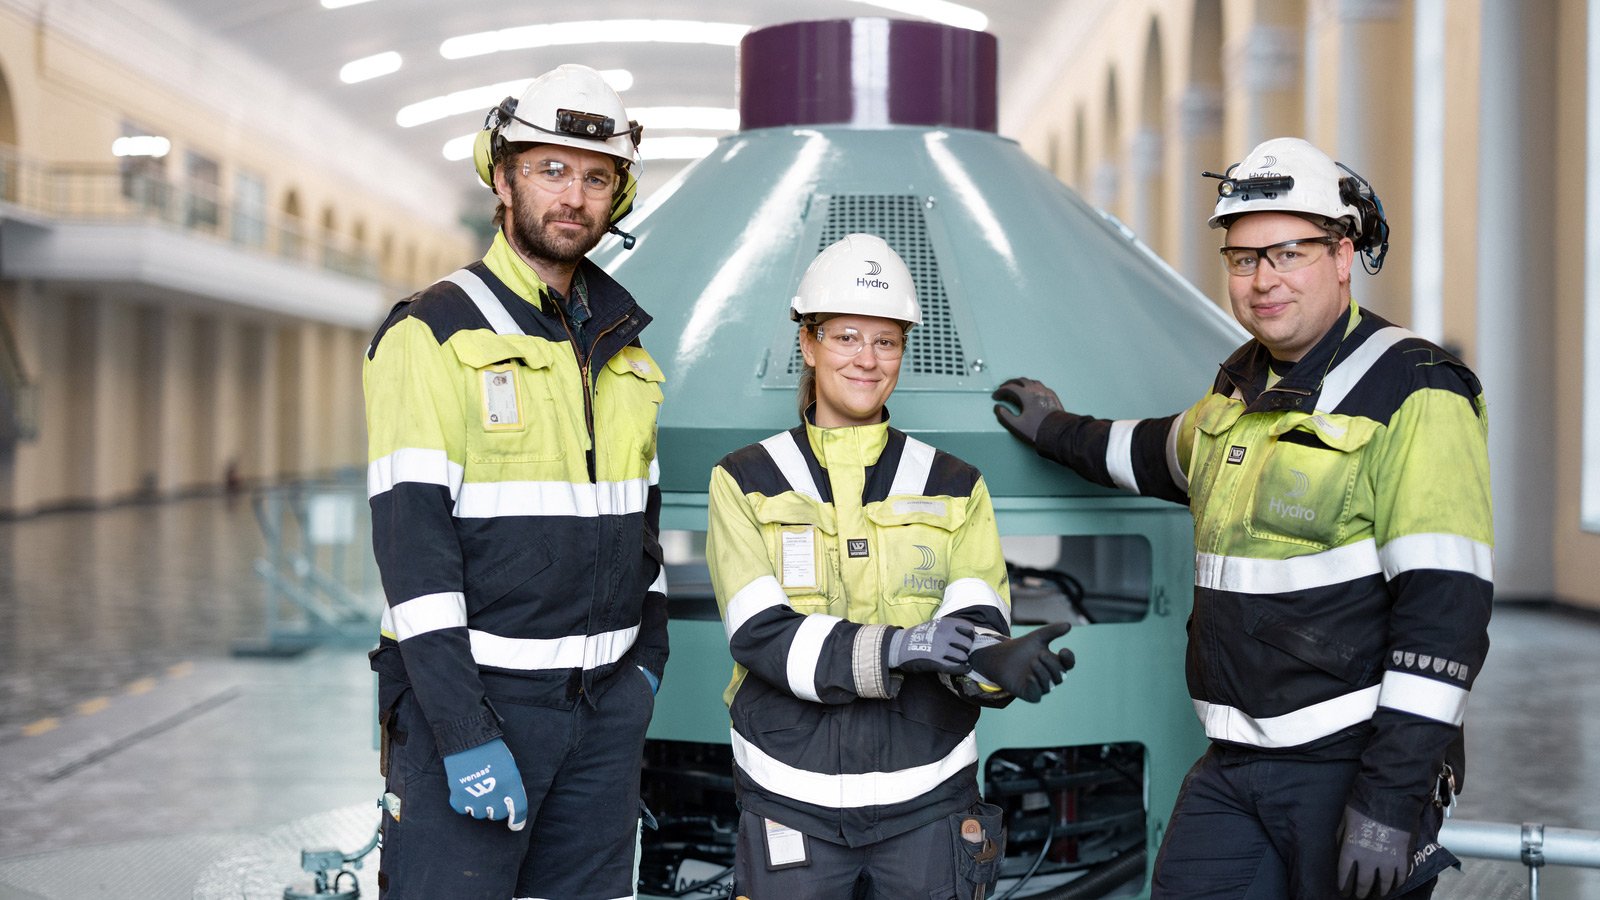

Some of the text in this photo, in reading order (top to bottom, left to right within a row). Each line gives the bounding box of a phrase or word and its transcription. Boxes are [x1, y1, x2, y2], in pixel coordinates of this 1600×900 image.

[856, 277, 889, 290] Hydro
[1268, 496, 1316, 521] Hydro
[904, 573, 946, 592] Hydro
